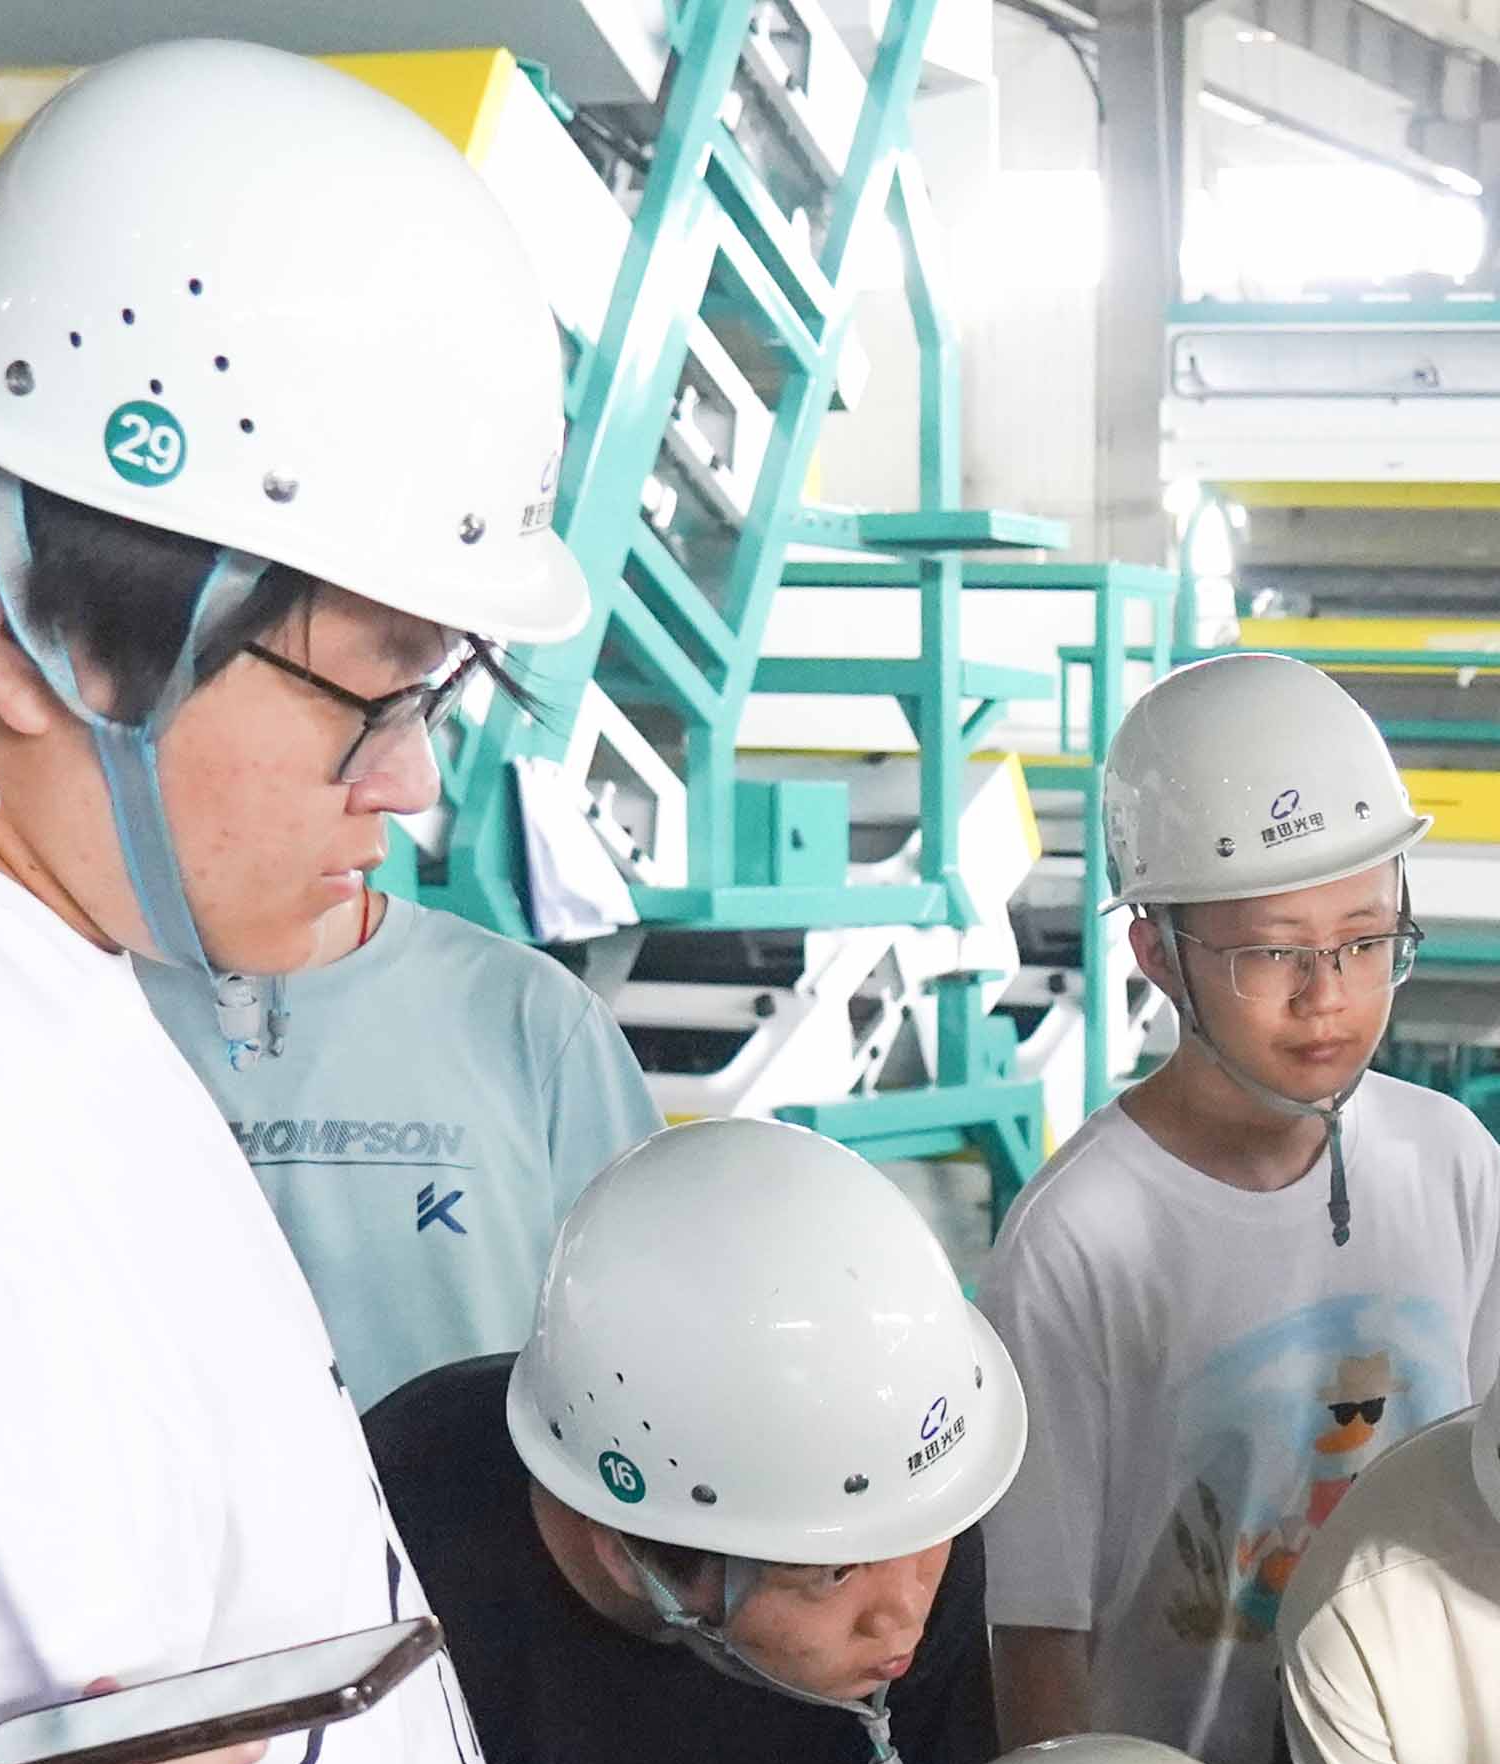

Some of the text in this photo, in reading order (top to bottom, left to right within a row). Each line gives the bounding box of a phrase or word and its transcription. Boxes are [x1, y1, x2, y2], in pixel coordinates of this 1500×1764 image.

[112, 413, 181, 474] 29
[229, 1118, 467, 1157] HOMPSON
[603, 1457, 637, 1491] 16
